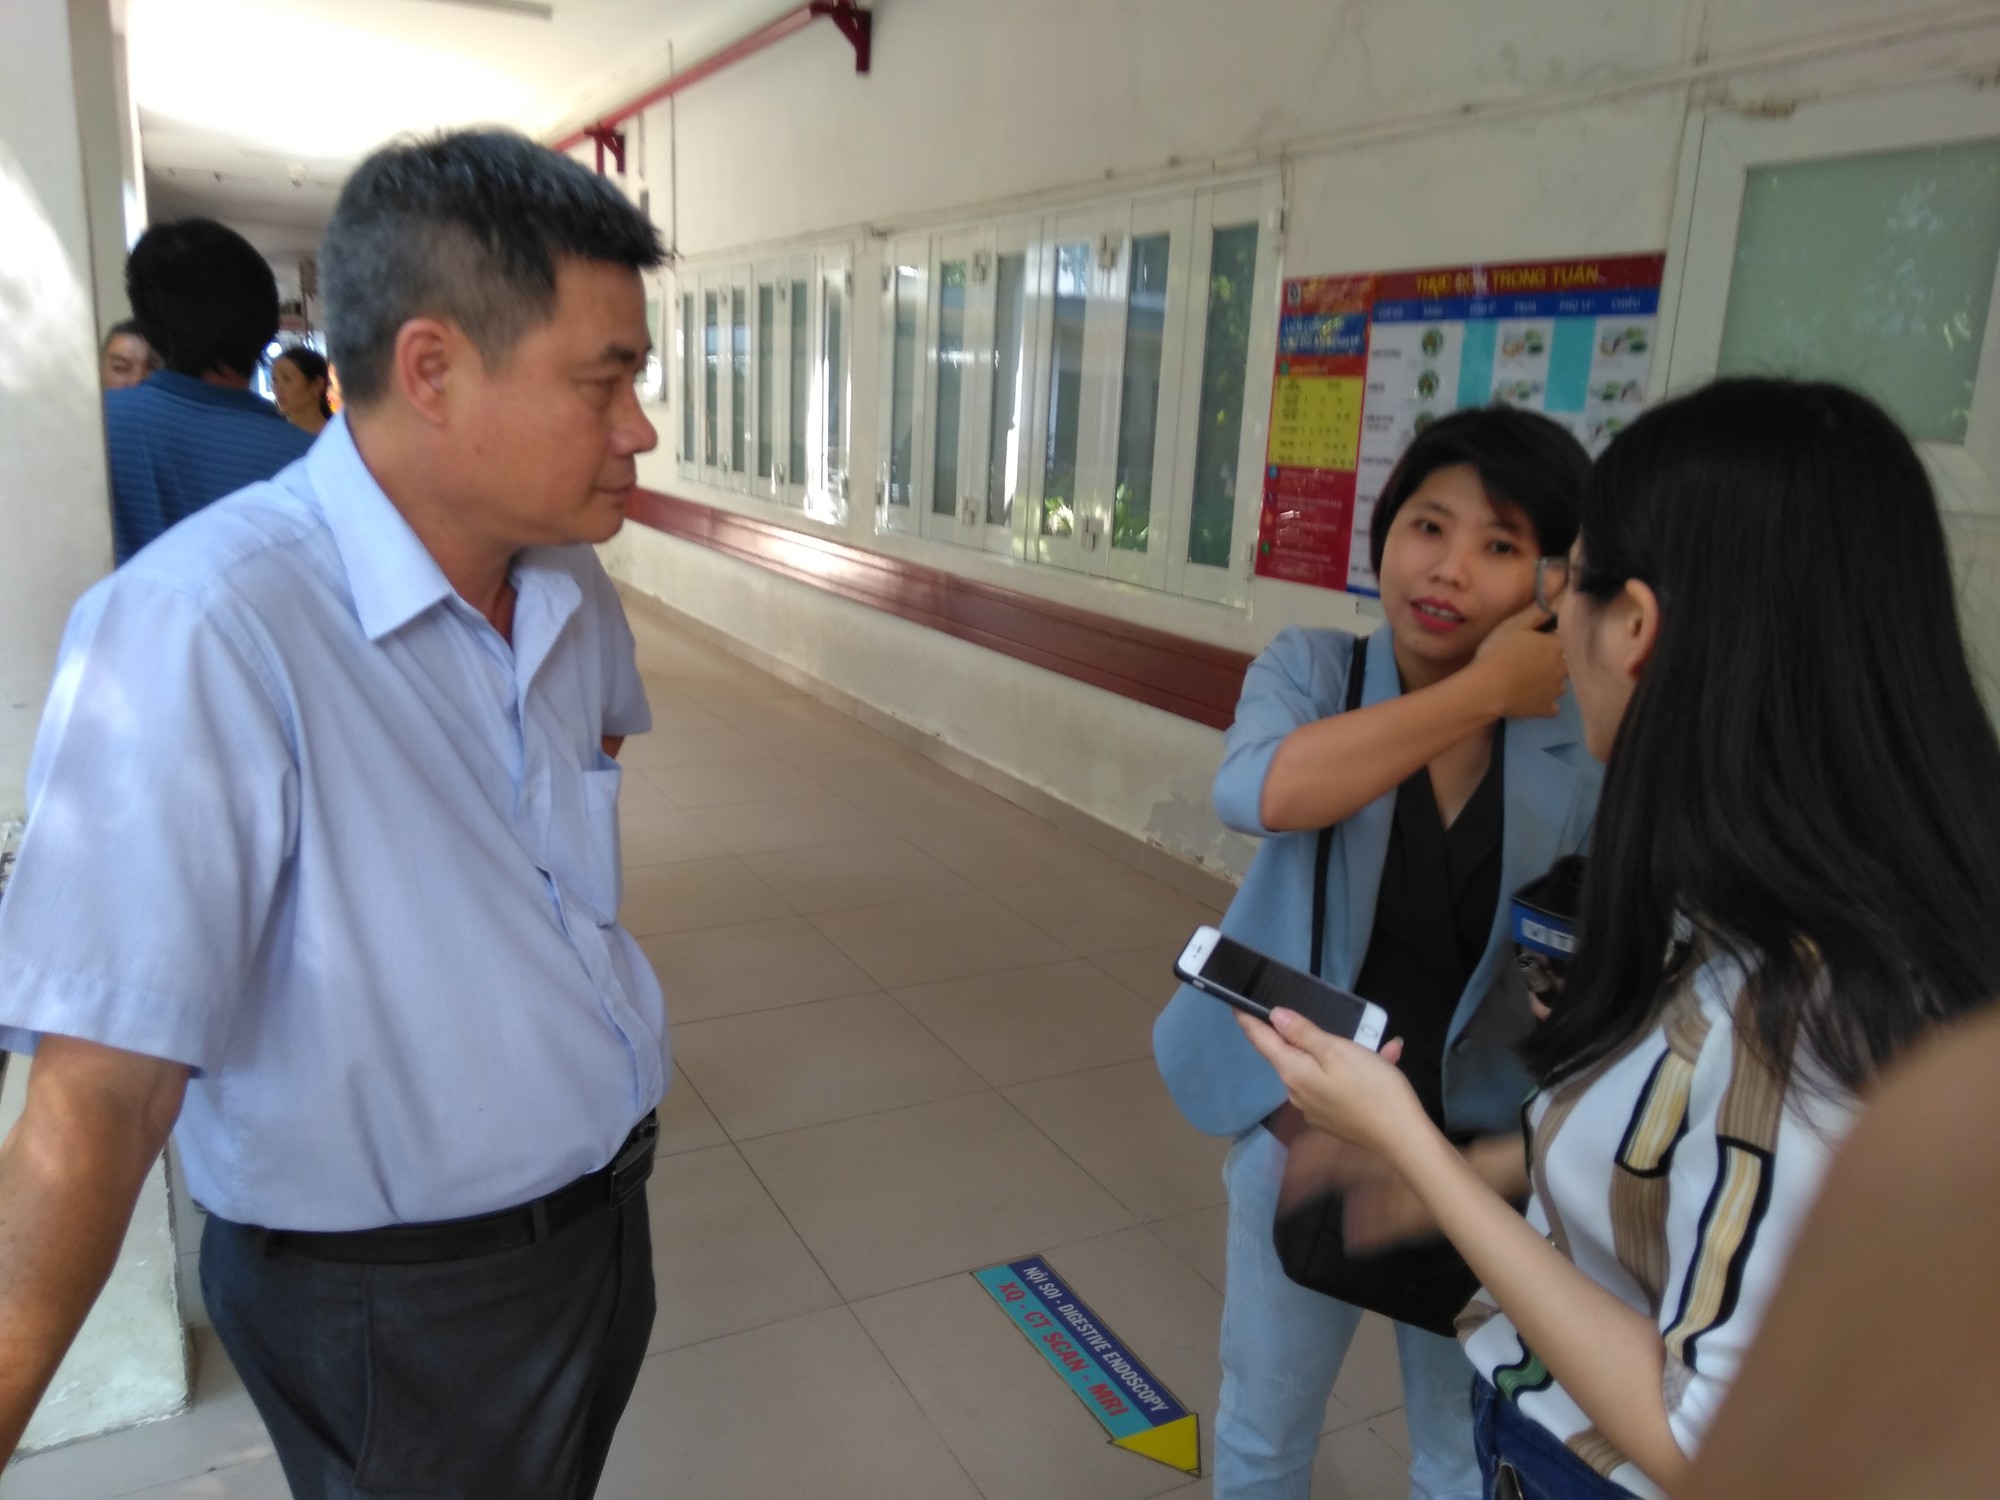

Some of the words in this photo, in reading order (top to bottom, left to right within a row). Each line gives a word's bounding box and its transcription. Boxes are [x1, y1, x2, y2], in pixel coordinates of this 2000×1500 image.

[1491, 267, 1546, 291] TRONG
[997, 1281, 1026, 1303] XQ
[1023, 1310, 1054, 1329] CT
[1042, 1331, 1090, 1373] SCAN
[1088, 1382, 1130, 1417] MRI
[1023, 1266, 1046, 1286] NỘI
[1038, 1281, 1062, 1300] SOI
[1058, 1303, 1112, 1353] DIGESTIVE
[1102, 1351, 1169, 1412] ENDOSCOPY
